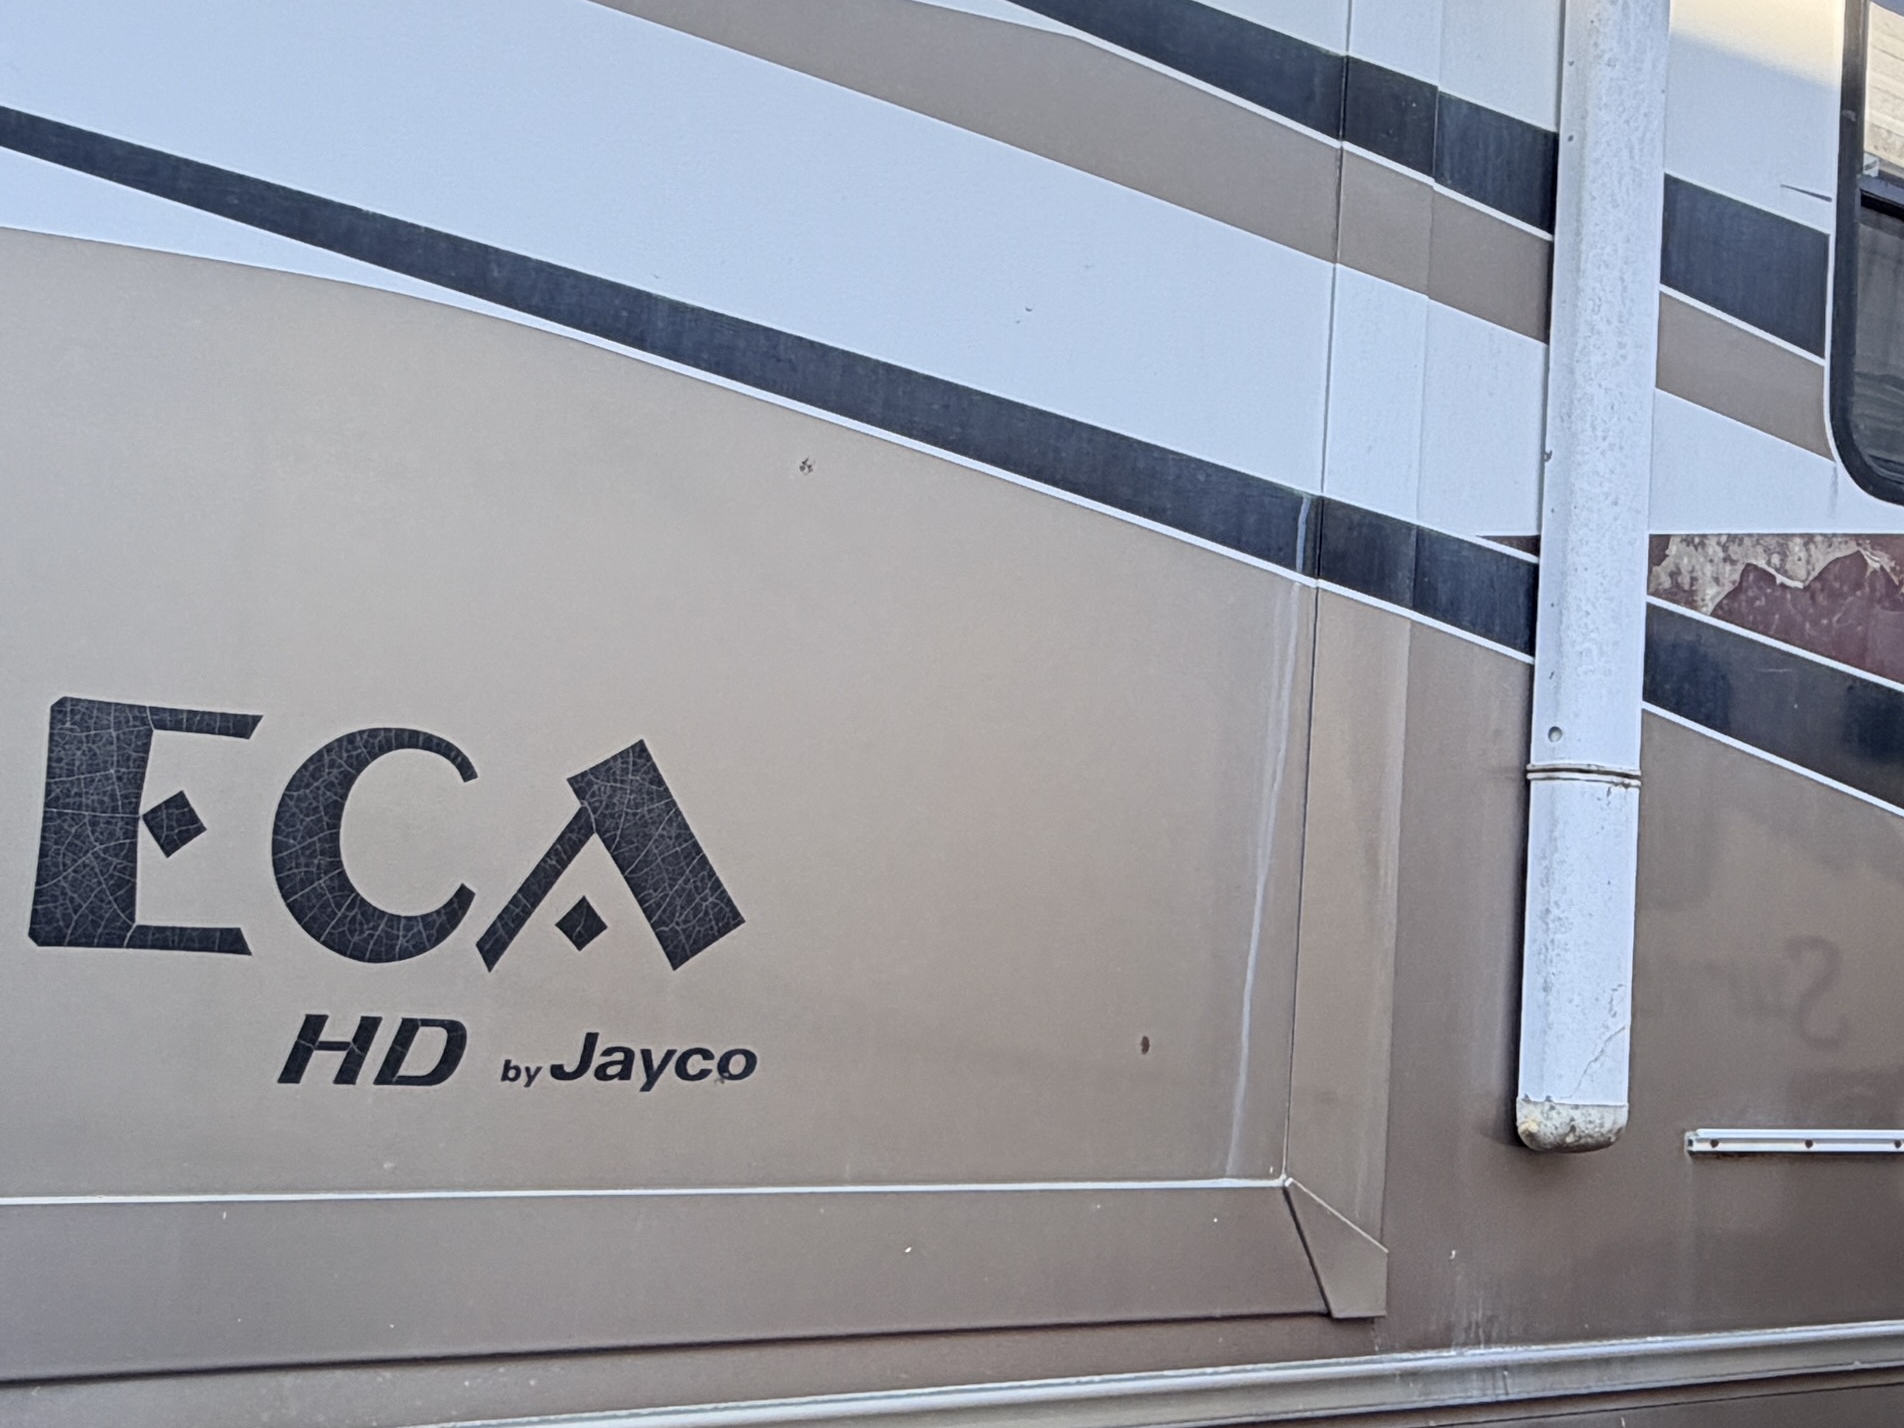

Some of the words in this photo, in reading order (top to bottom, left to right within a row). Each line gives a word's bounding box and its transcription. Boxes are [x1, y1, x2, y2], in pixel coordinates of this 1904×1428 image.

[277, 1013, 468, 1087] HD
[500, 1058, 543, 1088] by
[549, 1031, 758, 1093] Jayco
